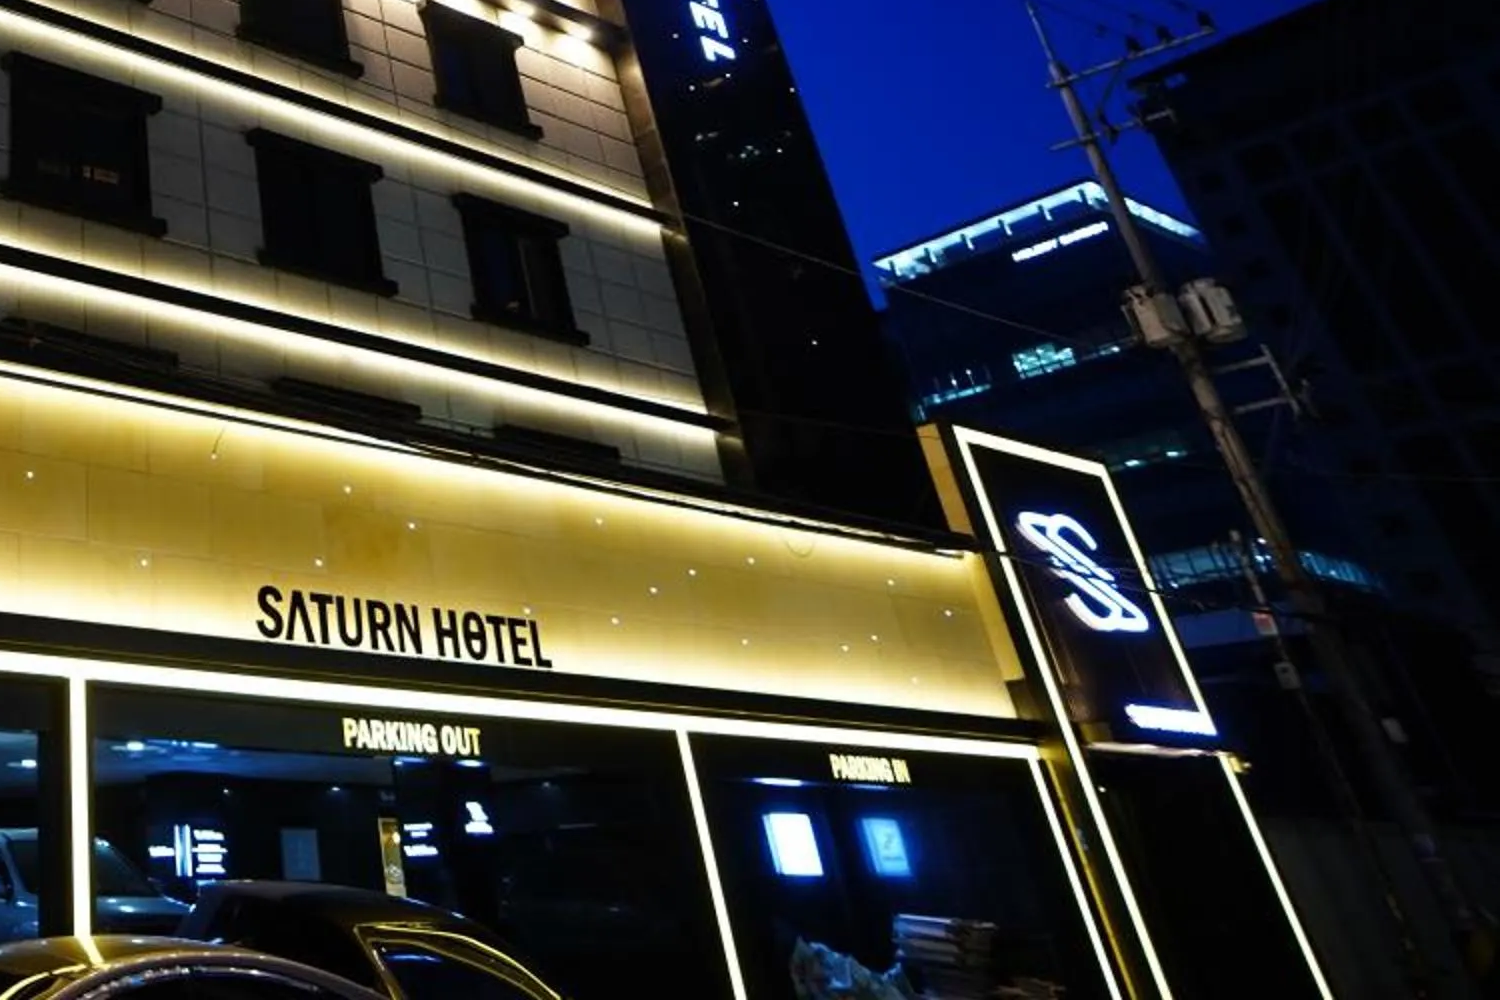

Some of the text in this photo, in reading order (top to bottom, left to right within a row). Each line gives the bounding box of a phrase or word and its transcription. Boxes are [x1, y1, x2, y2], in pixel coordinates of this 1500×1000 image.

[256, 585, 553, 669] SATURN HOTEL
[342, 717, 481, 756] PARKING OUT
[828, 753, 911, 784] PARKING IN
